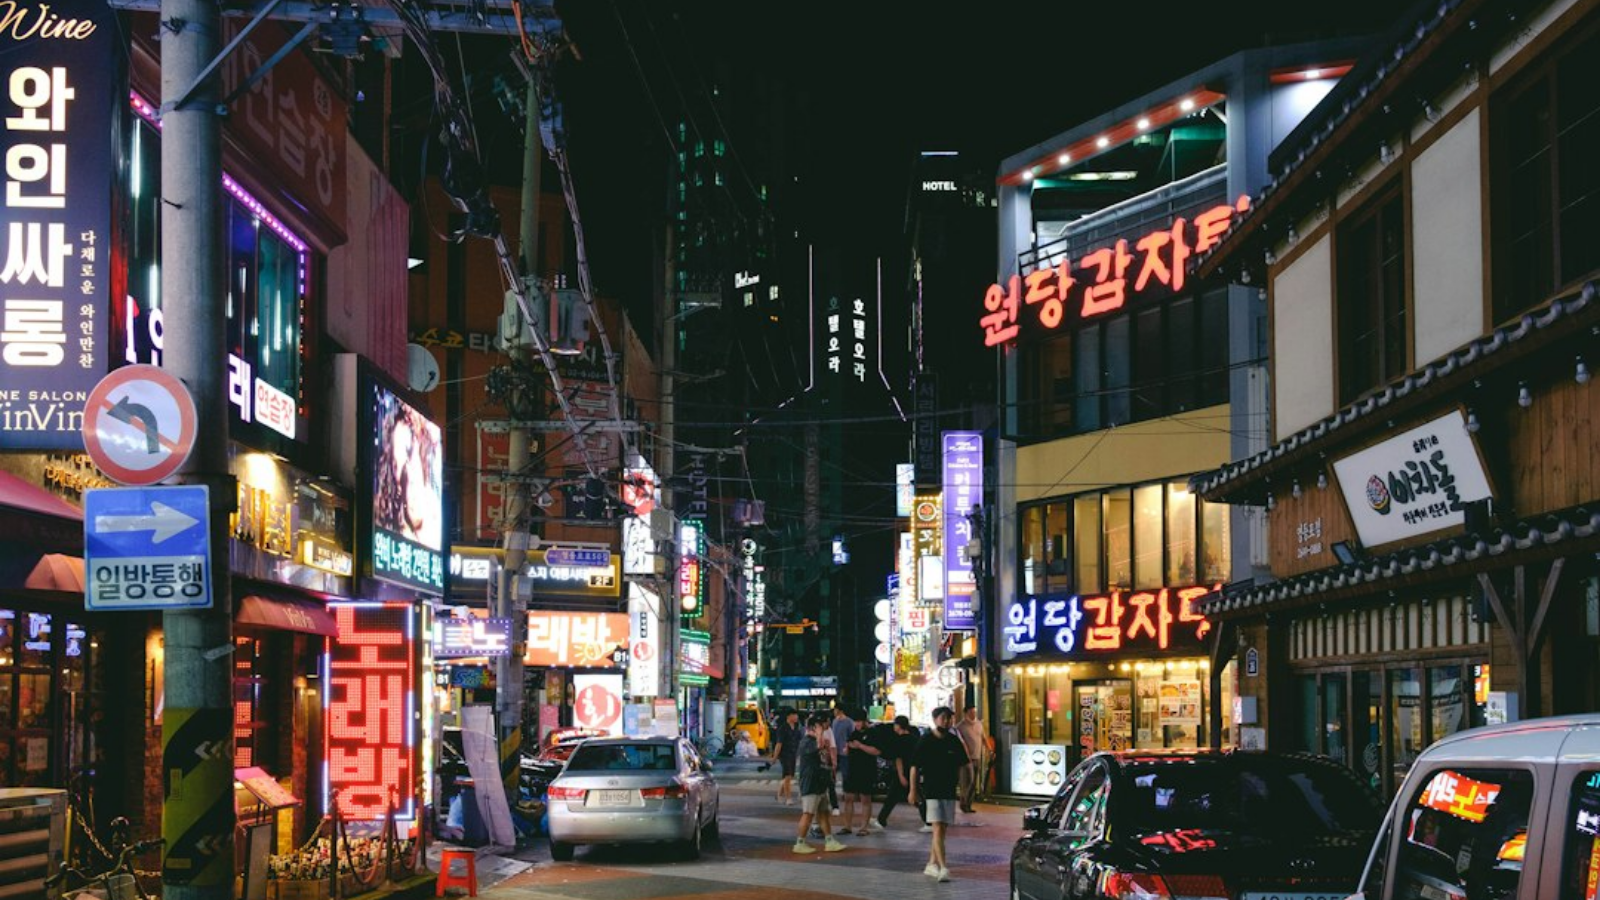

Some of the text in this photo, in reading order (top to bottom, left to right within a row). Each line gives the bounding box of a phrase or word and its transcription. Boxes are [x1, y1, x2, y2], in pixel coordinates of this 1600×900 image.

[0, 1, 97, 40] Wine
[922, 181, 957, 191] HOTEL
[979, 194, 1251, 347] 원당감자
[78, 230, 96, 369] 다채로운 와인만찬
[29, 391, 86, 401] SALON
[257, 385, 293, 431] 연습장
[1387, 449, 1466, 512] 이차돌
[96, 563, 203, 600] 일방통행
[595, 576, 610, 586] 2F
[328, 604, 410, 818] 노래방
